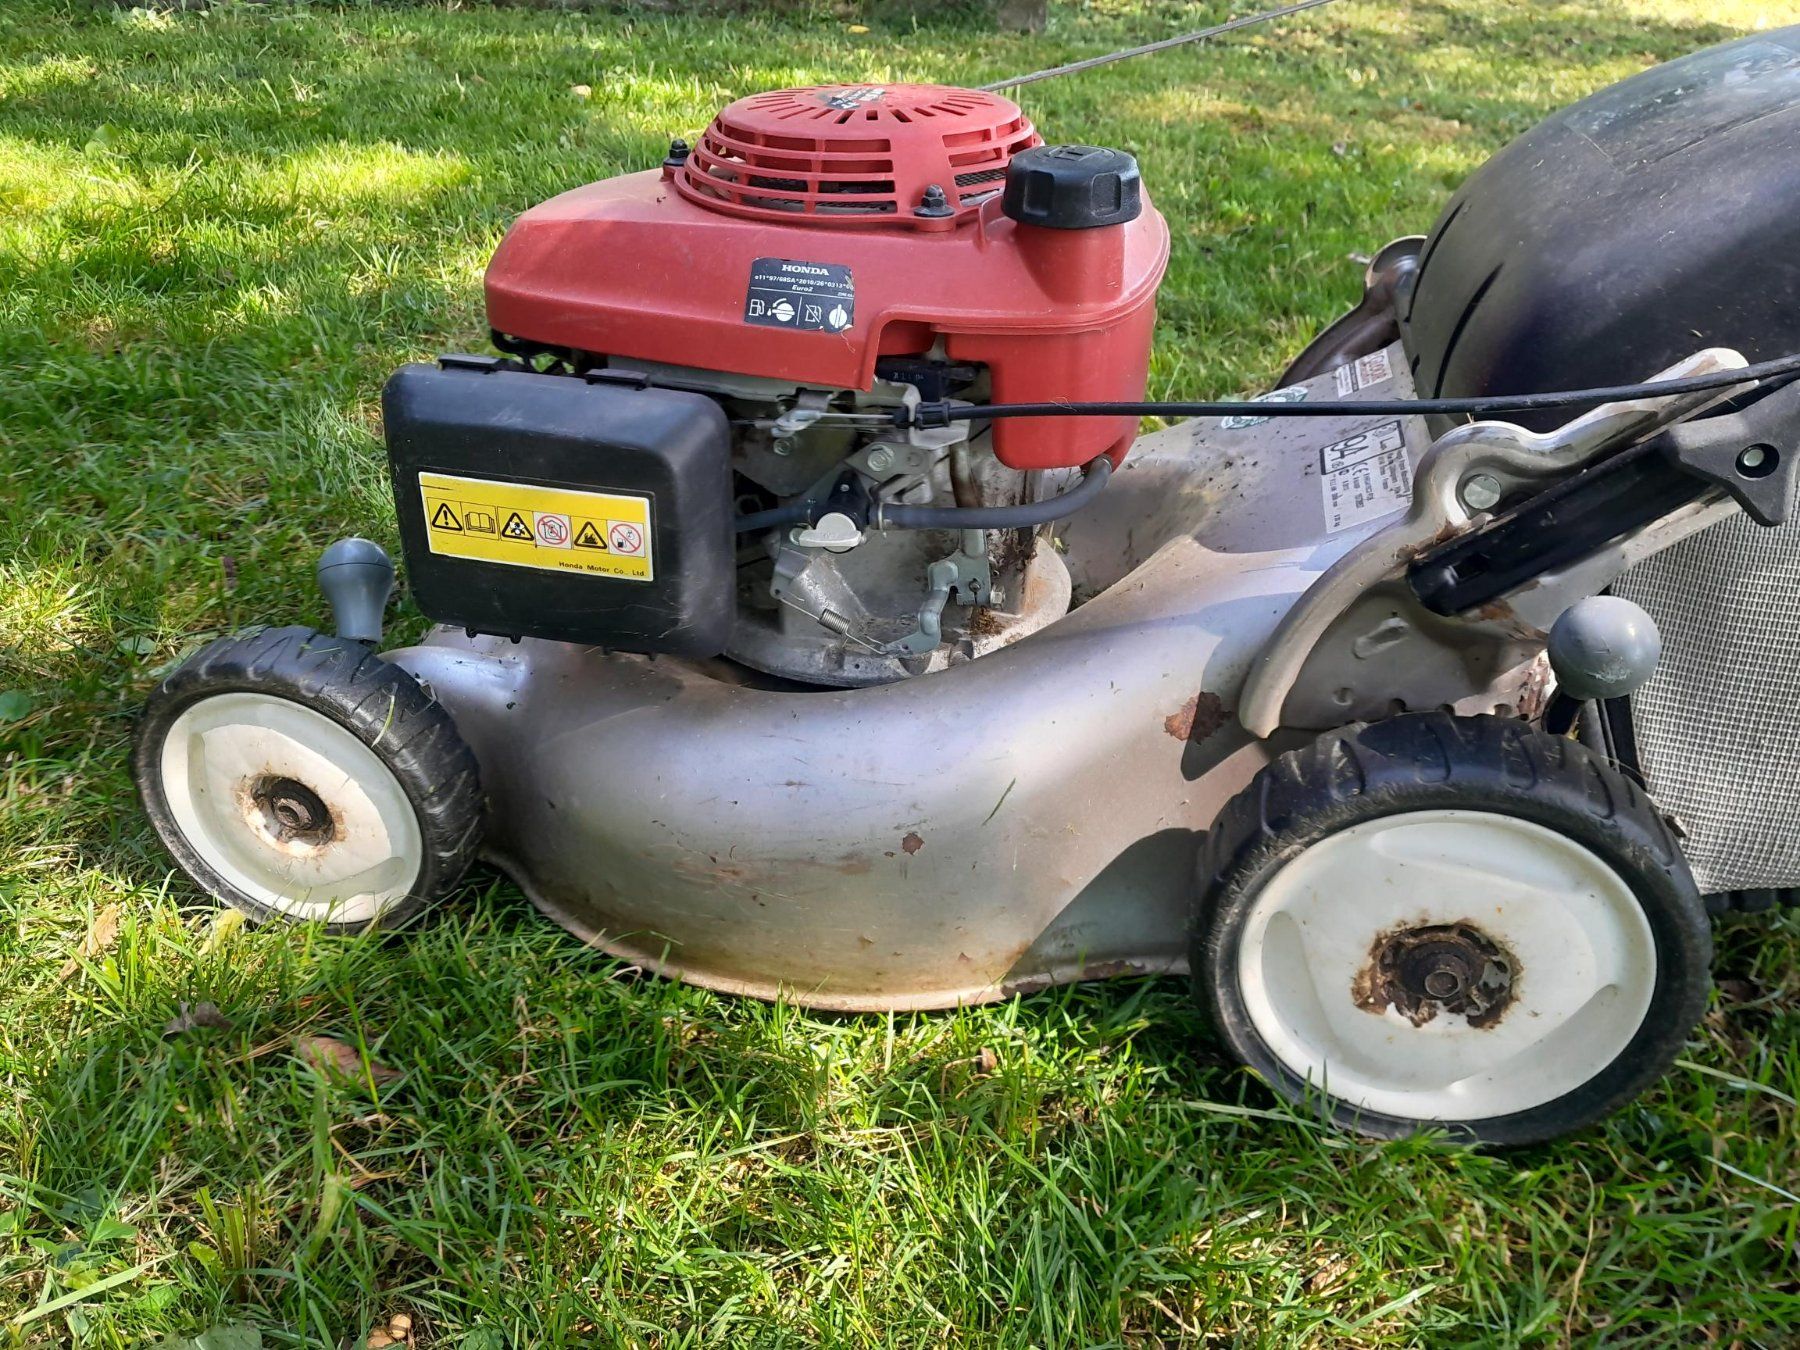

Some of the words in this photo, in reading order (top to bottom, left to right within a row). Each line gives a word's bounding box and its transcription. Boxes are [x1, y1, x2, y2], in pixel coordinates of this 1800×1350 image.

[781, 264, 829, 276] HONDA
[1330, 433, 1369, 462] 94
[558, 561, 583, 570] Honda
[587, 565, 610, 573] Motor
